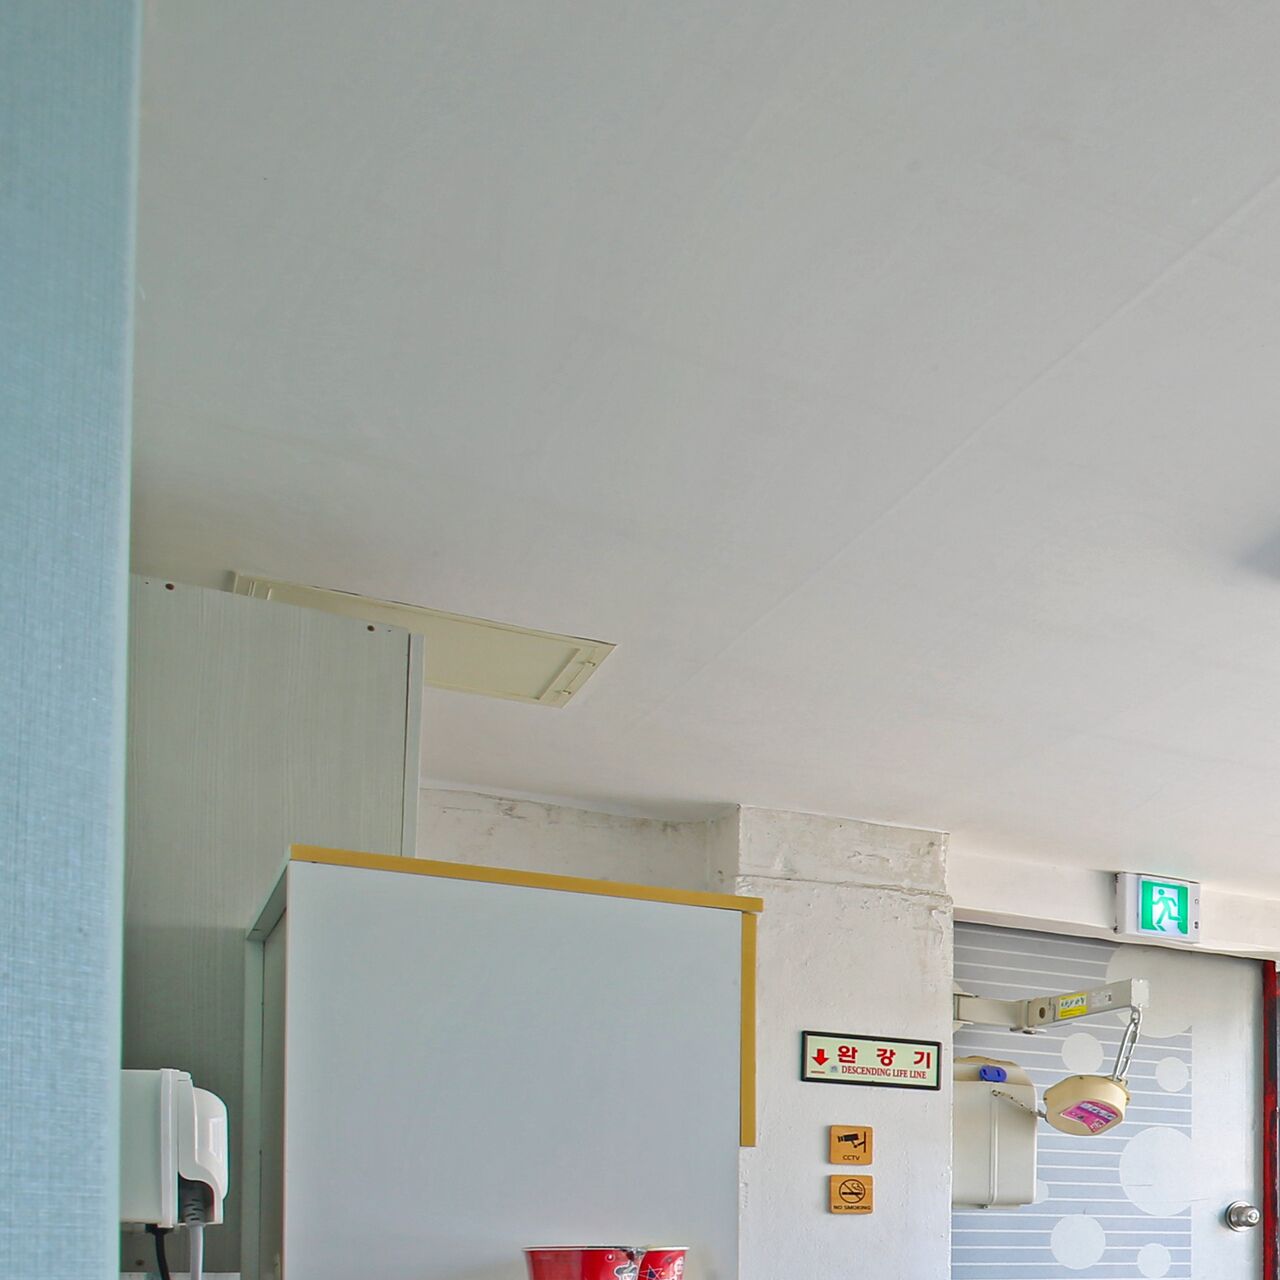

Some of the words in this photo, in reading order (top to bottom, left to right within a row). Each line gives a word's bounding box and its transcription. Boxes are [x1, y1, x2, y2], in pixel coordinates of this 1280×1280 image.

[841, 1065, 891, 1077] DESCENDING
[892, 1069, 908, 1078] LIFE
[909, 1070, 927, 1079] LINE
